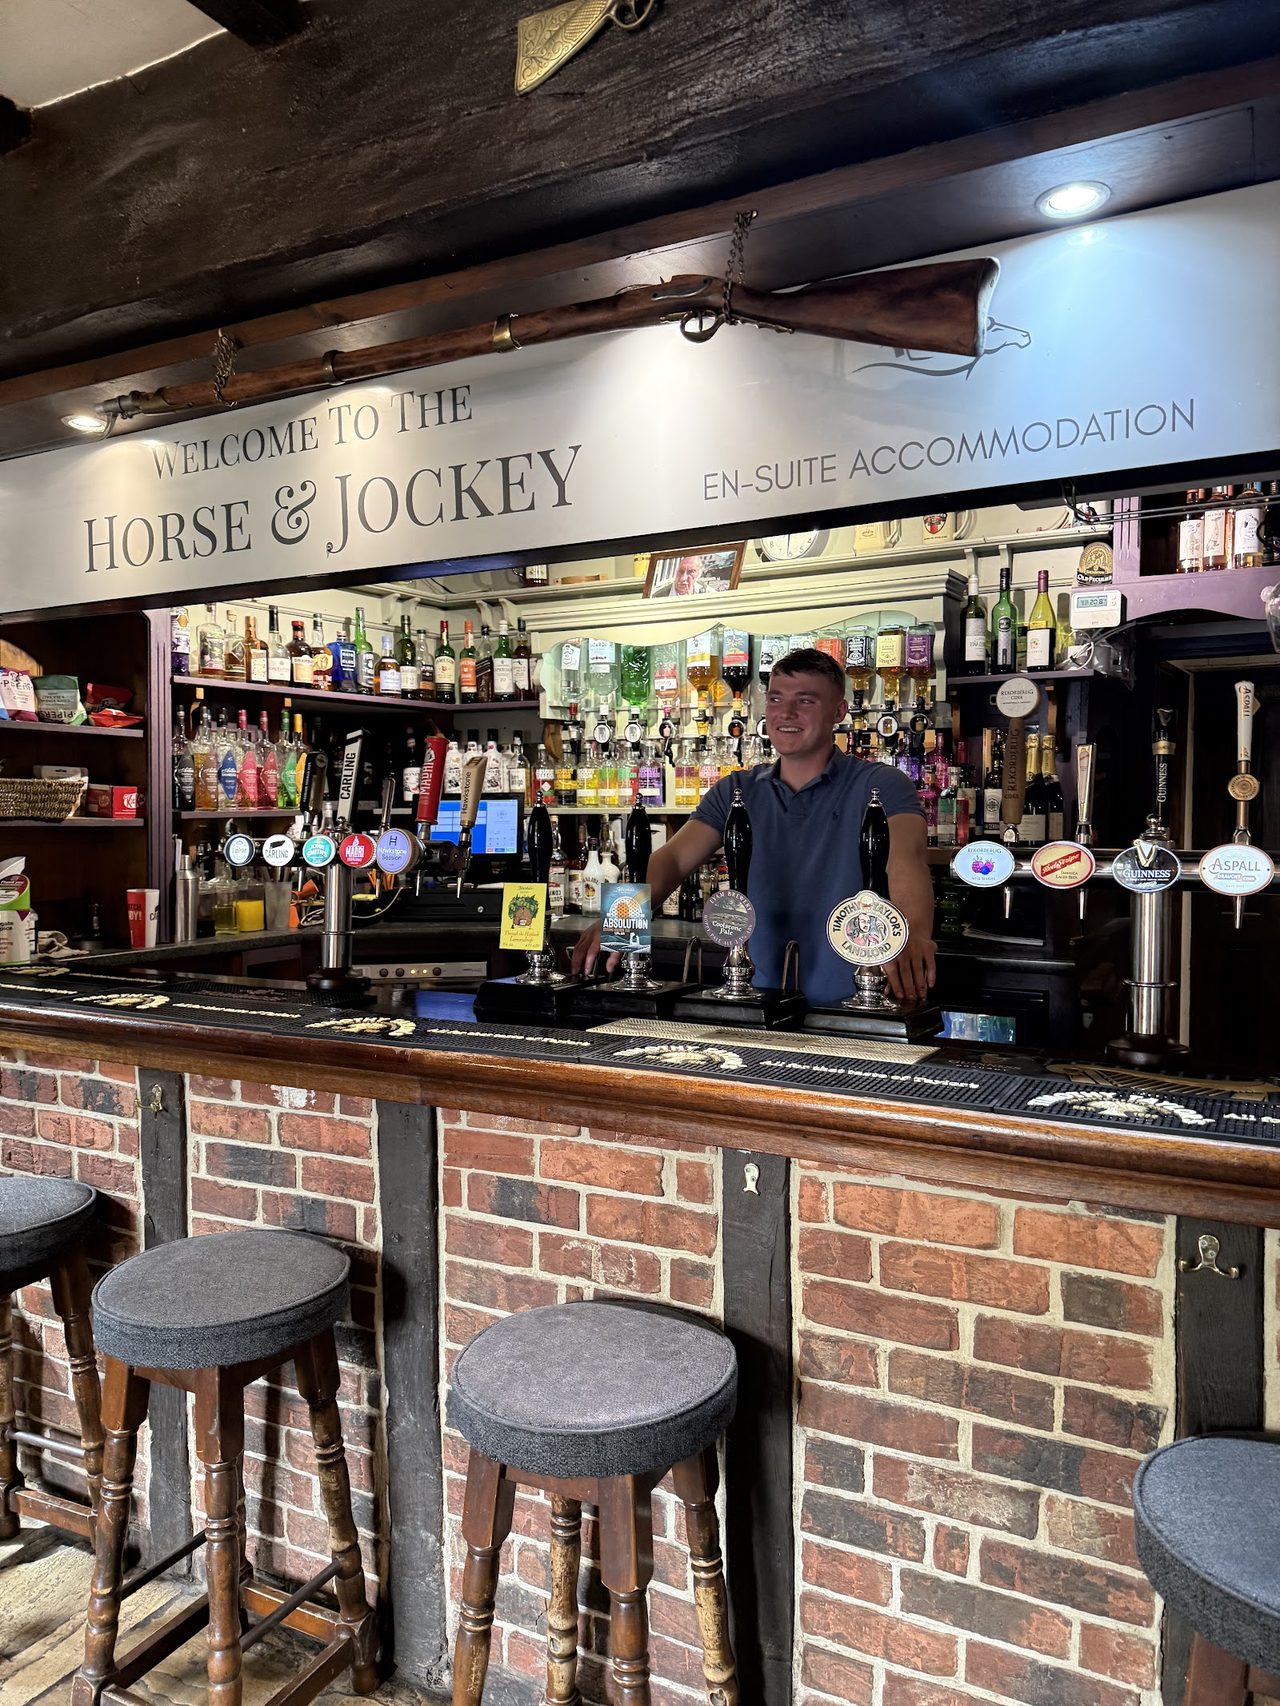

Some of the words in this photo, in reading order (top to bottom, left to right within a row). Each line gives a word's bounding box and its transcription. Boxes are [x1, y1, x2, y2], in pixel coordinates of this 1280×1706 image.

[152, 418, 319, 479] WELCOME
[328, 402, 379, 445] TO
[391, 385, 473, 433] THE
[704, 454, 837, 501] EN-SUITE
[849, 398, 1195, 480] ACCOMMODATION
[84, 500, 252, 573] HORSE
[271, 479, 317, 545] &
[326, 444, 583, 558] JOCKEY
[340, 752, 357, 800] CARLING
[1157, 762, 1168, 803] GUINNESS
[462, 771, 473, 815] Hawkstone
[265, 849, 289, 859] CARLING
[1122, 869, 1171, 878] GUINNESS
[1209, 857, 1261, 874] ASPALL
[602, 918, 649, 930] ABSOLUTION
[873, 902, 903, 938] TAYLOR'S
[719, 927, 734, 936] Pale
[841, 940, 892, 958] LANDLORD
[760, 1060, 786, 1068] All
[812, 1065, 845, 1074] that
[847, 1069, 888, 1079] taste
[891, 1074, 912, 1082] of
[1222, 1112, 1257, 1122] All
